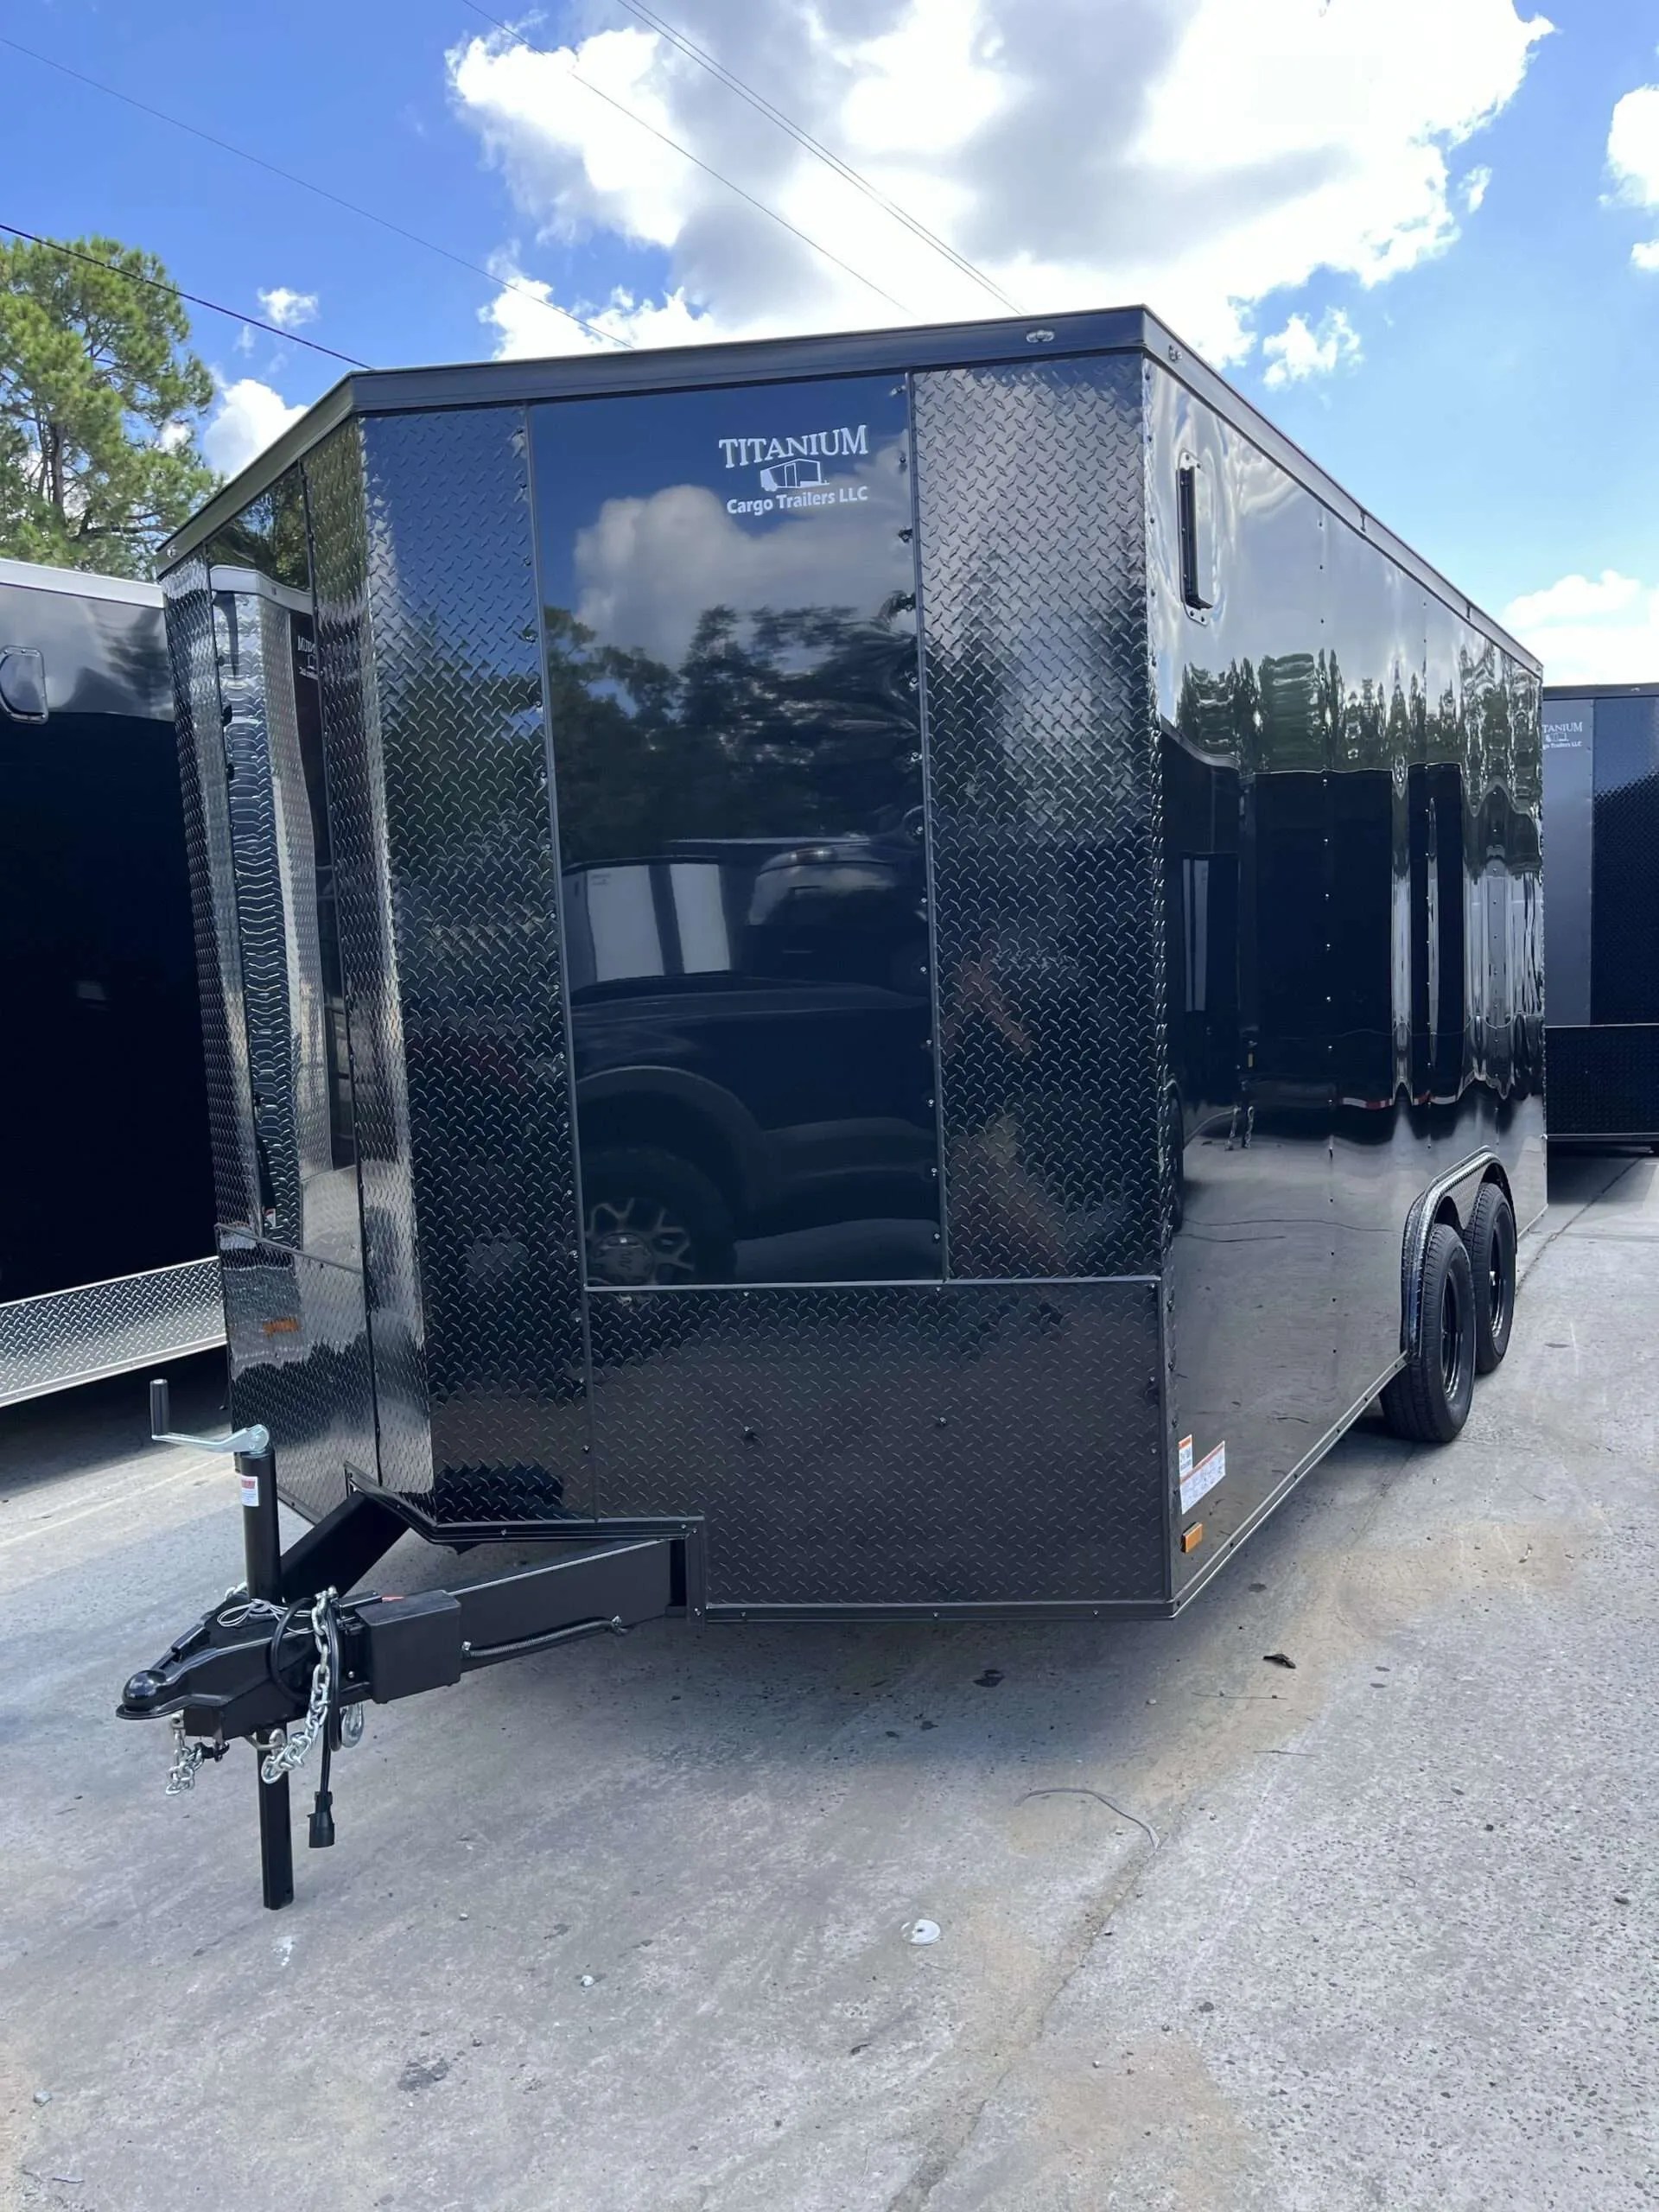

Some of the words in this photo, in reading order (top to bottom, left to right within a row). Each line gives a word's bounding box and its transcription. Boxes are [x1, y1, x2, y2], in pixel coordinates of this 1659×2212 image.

[719, 424, 868, 468] TITANIUM
[727, 499, 772, 516] Cargo
[776, 492, 836, 509] Trailers
[839, 486, 868, 502] LLC
[1541, 721, 1583, 734] TANIUM
